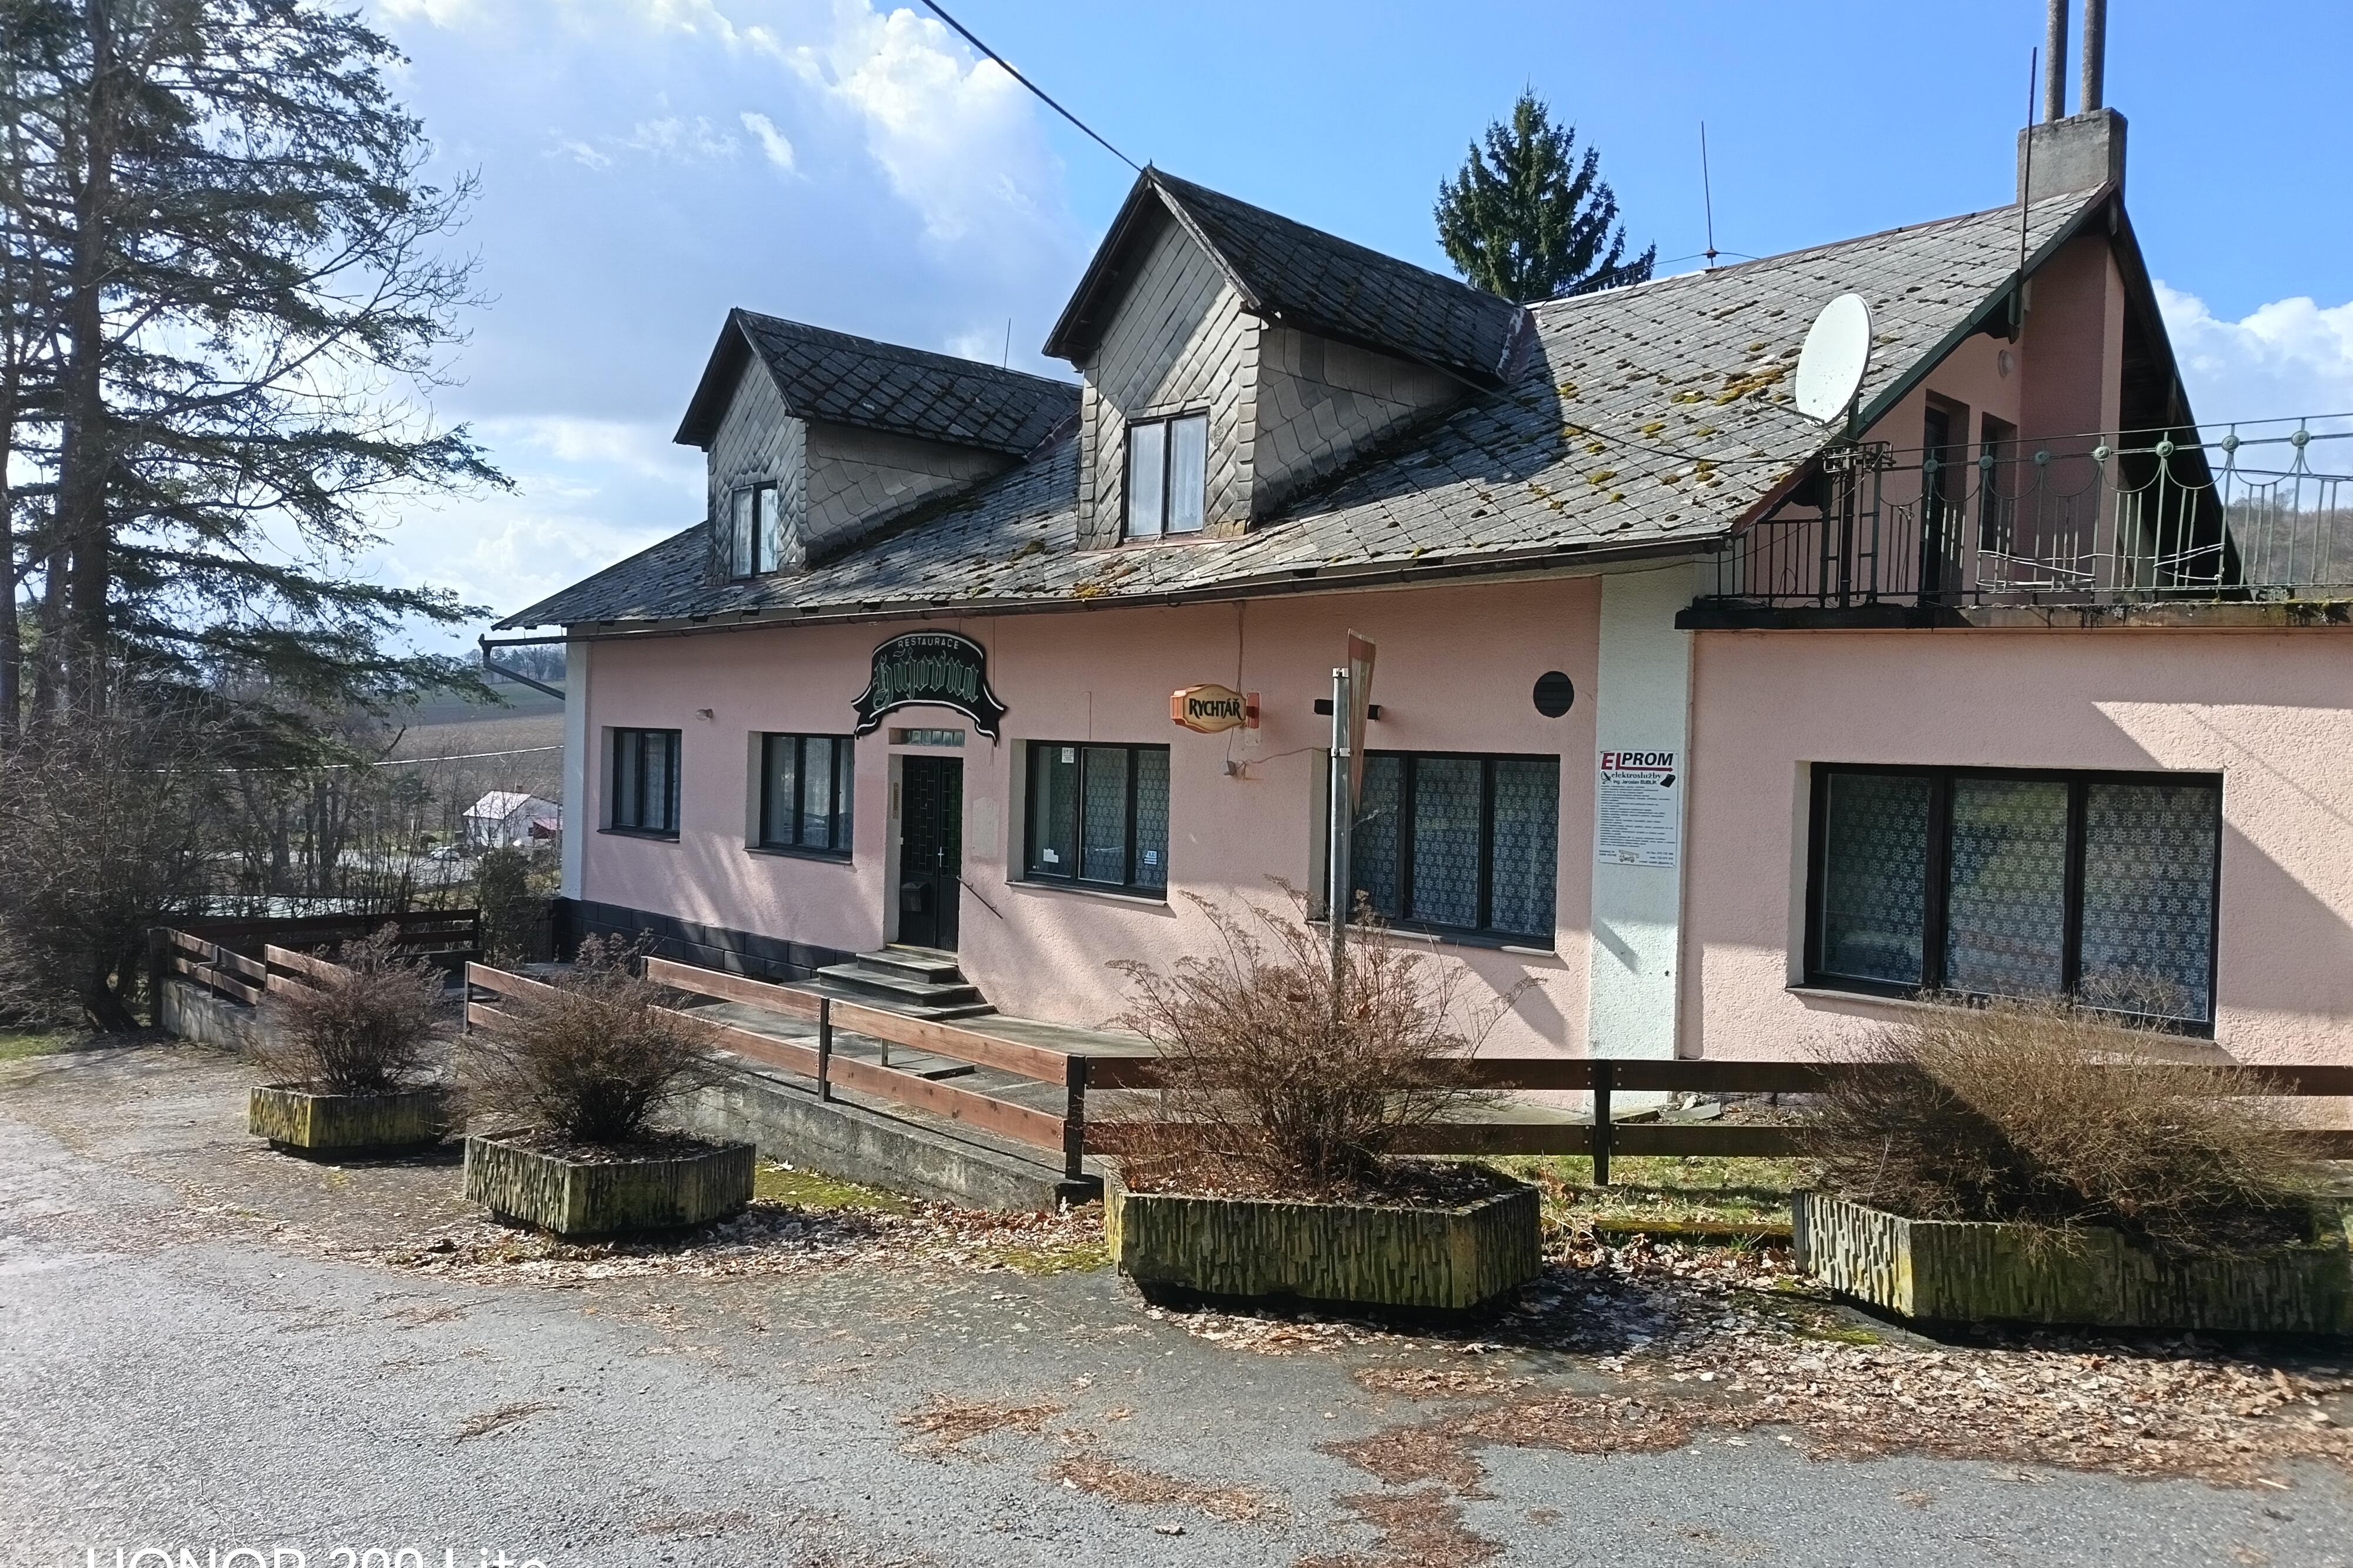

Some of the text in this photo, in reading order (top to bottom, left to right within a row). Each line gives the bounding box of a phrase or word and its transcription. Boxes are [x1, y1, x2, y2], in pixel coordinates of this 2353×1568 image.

[898, 637, 959, 649] RESTAURACE
[1189, 698, 1243, 720] RYCHTÁŘ
[1611, 771, 1662, 781] elektroslužby
